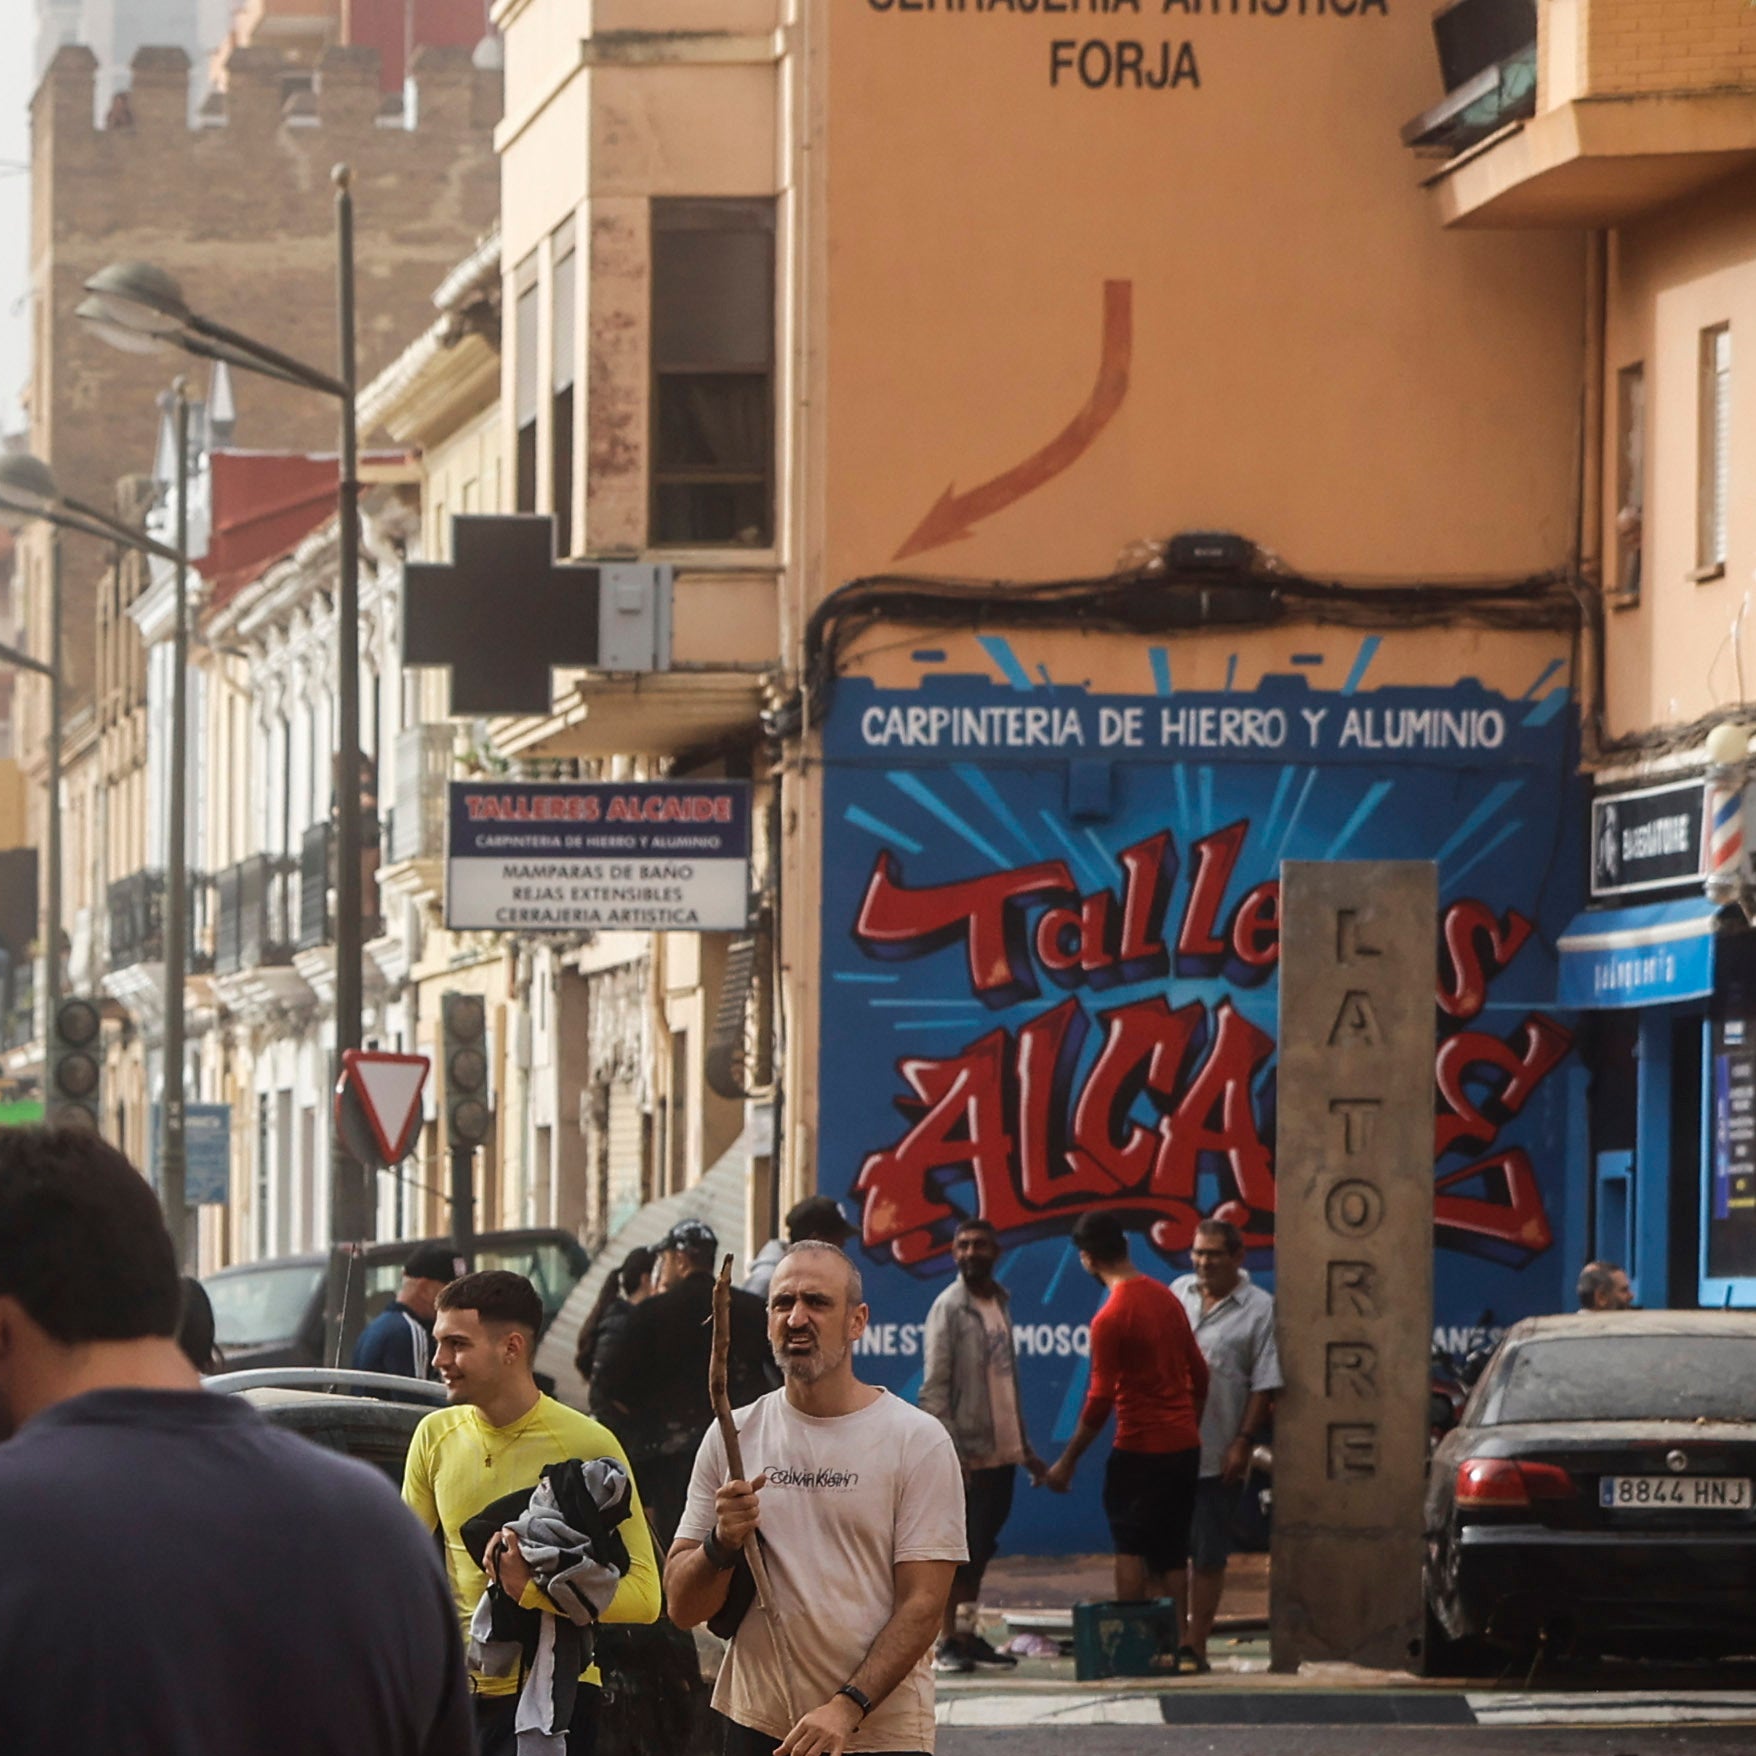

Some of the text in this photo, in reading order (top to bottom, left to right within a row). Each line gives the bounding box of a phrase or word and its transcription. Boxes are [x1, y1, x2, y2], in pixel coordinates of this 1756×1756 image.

[1049, 40, 1201, 89] FORJA
[862, 707, 1506, 748] CARPINTERIA DE HIERRO Y ALUMINIO
[465, 795, 732, 822] TALLERES ALCAIDE
[475, 834, 722, 849] CARPINTERIA DE HIERRO Y ALUMINIO
[502, 860, 694, 880] MAMPARAS DE BAÑO
[512, 886, 683, 901] REJAS EXTENSIBLES
[496, 908, 699, 924] CERRAJERIA ARTISTICA
[854, 818, 1536, 1017] Talles
[1324, 909, 1386, 1480] LA TORRE
[1013, 1324, 1092, 1357] MOSQ
[1618, 1480, 1684, 1503] 8844
[1694, 1481, 1745, 1505] HNJ
